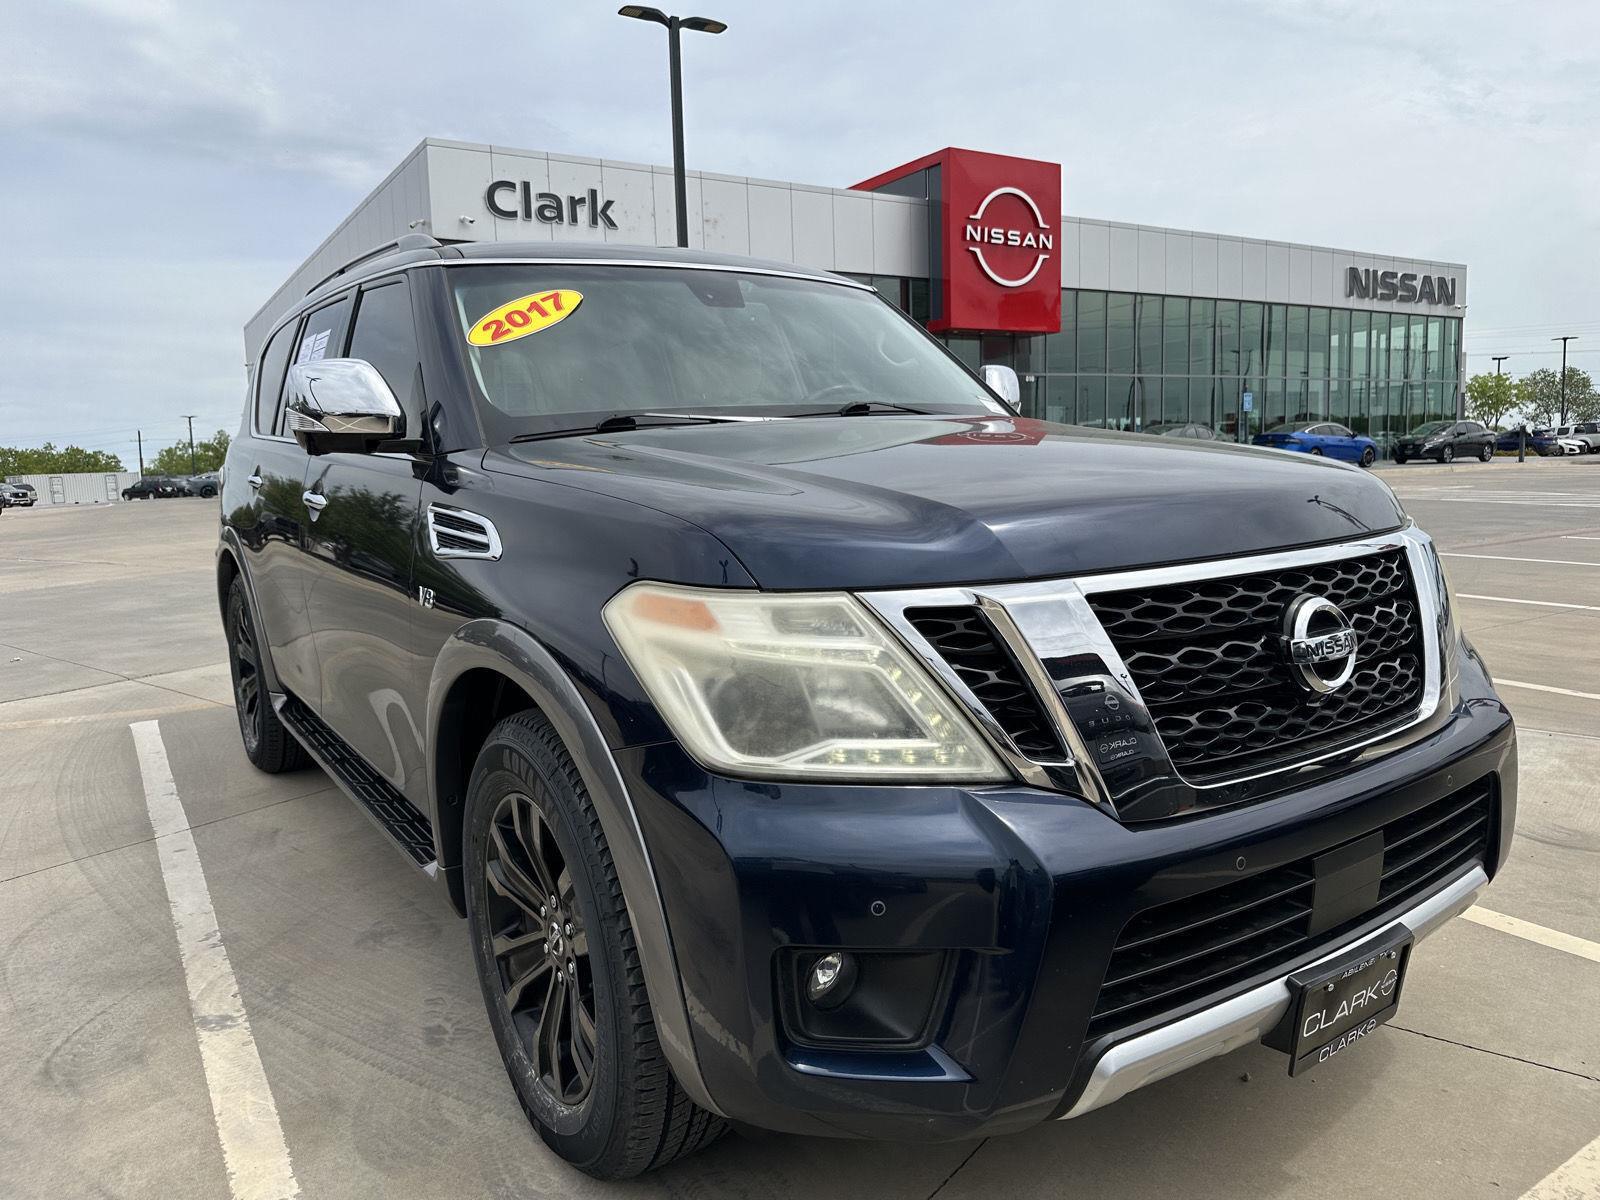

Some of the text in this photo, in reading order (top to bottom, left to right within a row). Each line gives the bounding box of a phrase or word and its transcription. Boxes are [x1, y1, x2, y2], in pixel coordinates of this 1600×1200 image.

[486, 180, 618, 230] Clark
[965, 224, 1054, 250] NISSAN
[1346, 267, 1457, 305] NISSAN
[482, 291, 564, 342] 2017
[419, 586, 435, 609] V8
[1306, 632, 1357, 658] NISSAN
[1303, 981, 1380, 1037] CLARK
[1318, 1024, 1366, 1062] CLARK
